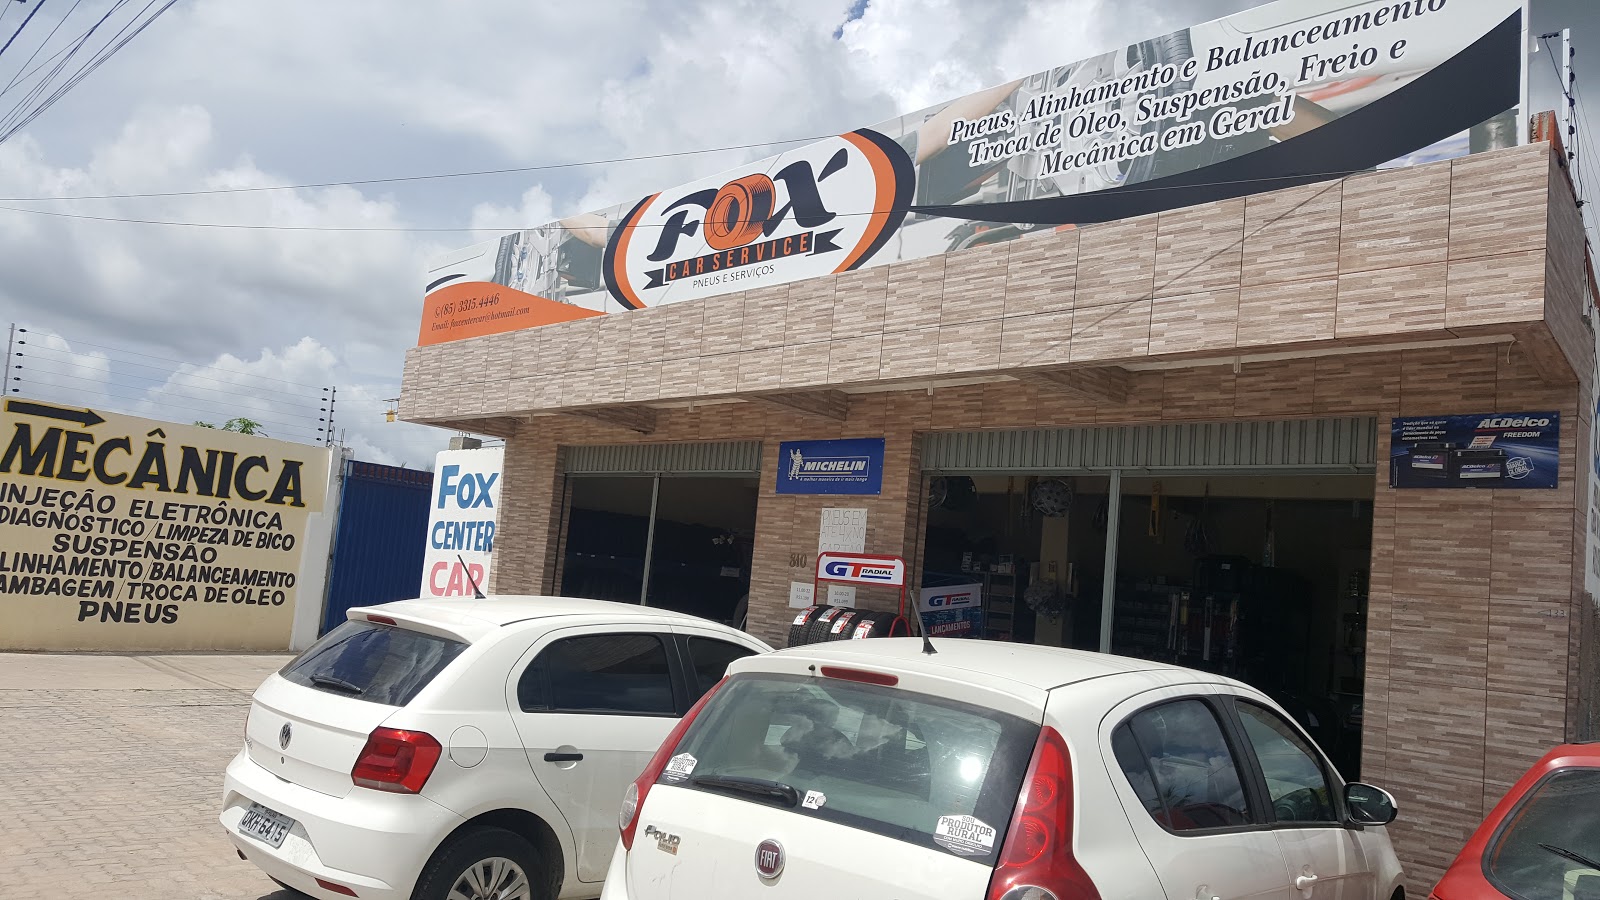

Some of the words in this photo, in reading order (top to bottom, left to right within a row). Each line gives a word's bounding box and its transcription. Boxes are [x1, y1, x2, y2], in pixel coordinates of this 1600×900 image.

[949, 112, 1016, 142] Pneus,
[1022, 65, 1175, 122] Alinhamento
[1183, 60, 1197, 78] e
[1205, 0, 1447, 73] Balanceamento
[970, 134, 1028, 164] Troca
[1035, 124, 1061, 148] de
[1070, 108, 1127, 138] Óleo,
[1136, 69, 1286, 122] Suspensão,
[1298, 43, 1378, 83] Freio
[1389, 39, 1407, 59] e
[1040, 134, 1155, 177] Mecânica
[1164, 124, 1202, 148] em
[1212, 95, 1292, 136] Geral
[669, 257, 704, 280] CAR
[713, 233, 808, 270] SERVICE
[692, 275, 720, 289] PNEUS
[723, 273, 729, 283] E
[730, 264, 775, 282] SERVIÇOS
[458, 293, 500, 313] 3315.4446
[431, 320, 449, 331] Email:
[1477, 416, 1550, 429] ACDelco
[0, 422, 306, 508] MECÂNICA
[804, 460, 867, 471] MICHELIN
[0, 482, 116, 514] INJEÇÃO
[129, 499, 283, 531] ELETRÔNICA
[232, 529, 255, 548] DE
[255, 531, 296, 552] BICO
[431, 520, 496, 553] CENTER
[52, 533, 218, 564] SUSPENSÃO
[429, 561, 485, 598] CAR
[825, 561, 895, 577] GT
[861, 568, 894, 576] RADIAL
[204, 586, 229, 603] DE
[231, 585, 286, 606] ÓLEO
[78, 600, 179, 624] PNEUS
[931, 620, 971, 635] LANÇAMENTOS
[805, 795, 815, 804] 12
[941, 816, 993, 838] PRODUTOR
[961, 815, 976, 824] SOU
[947, 826, 982, 843] RURAL
[760, 849, 778, 869] FIAT
